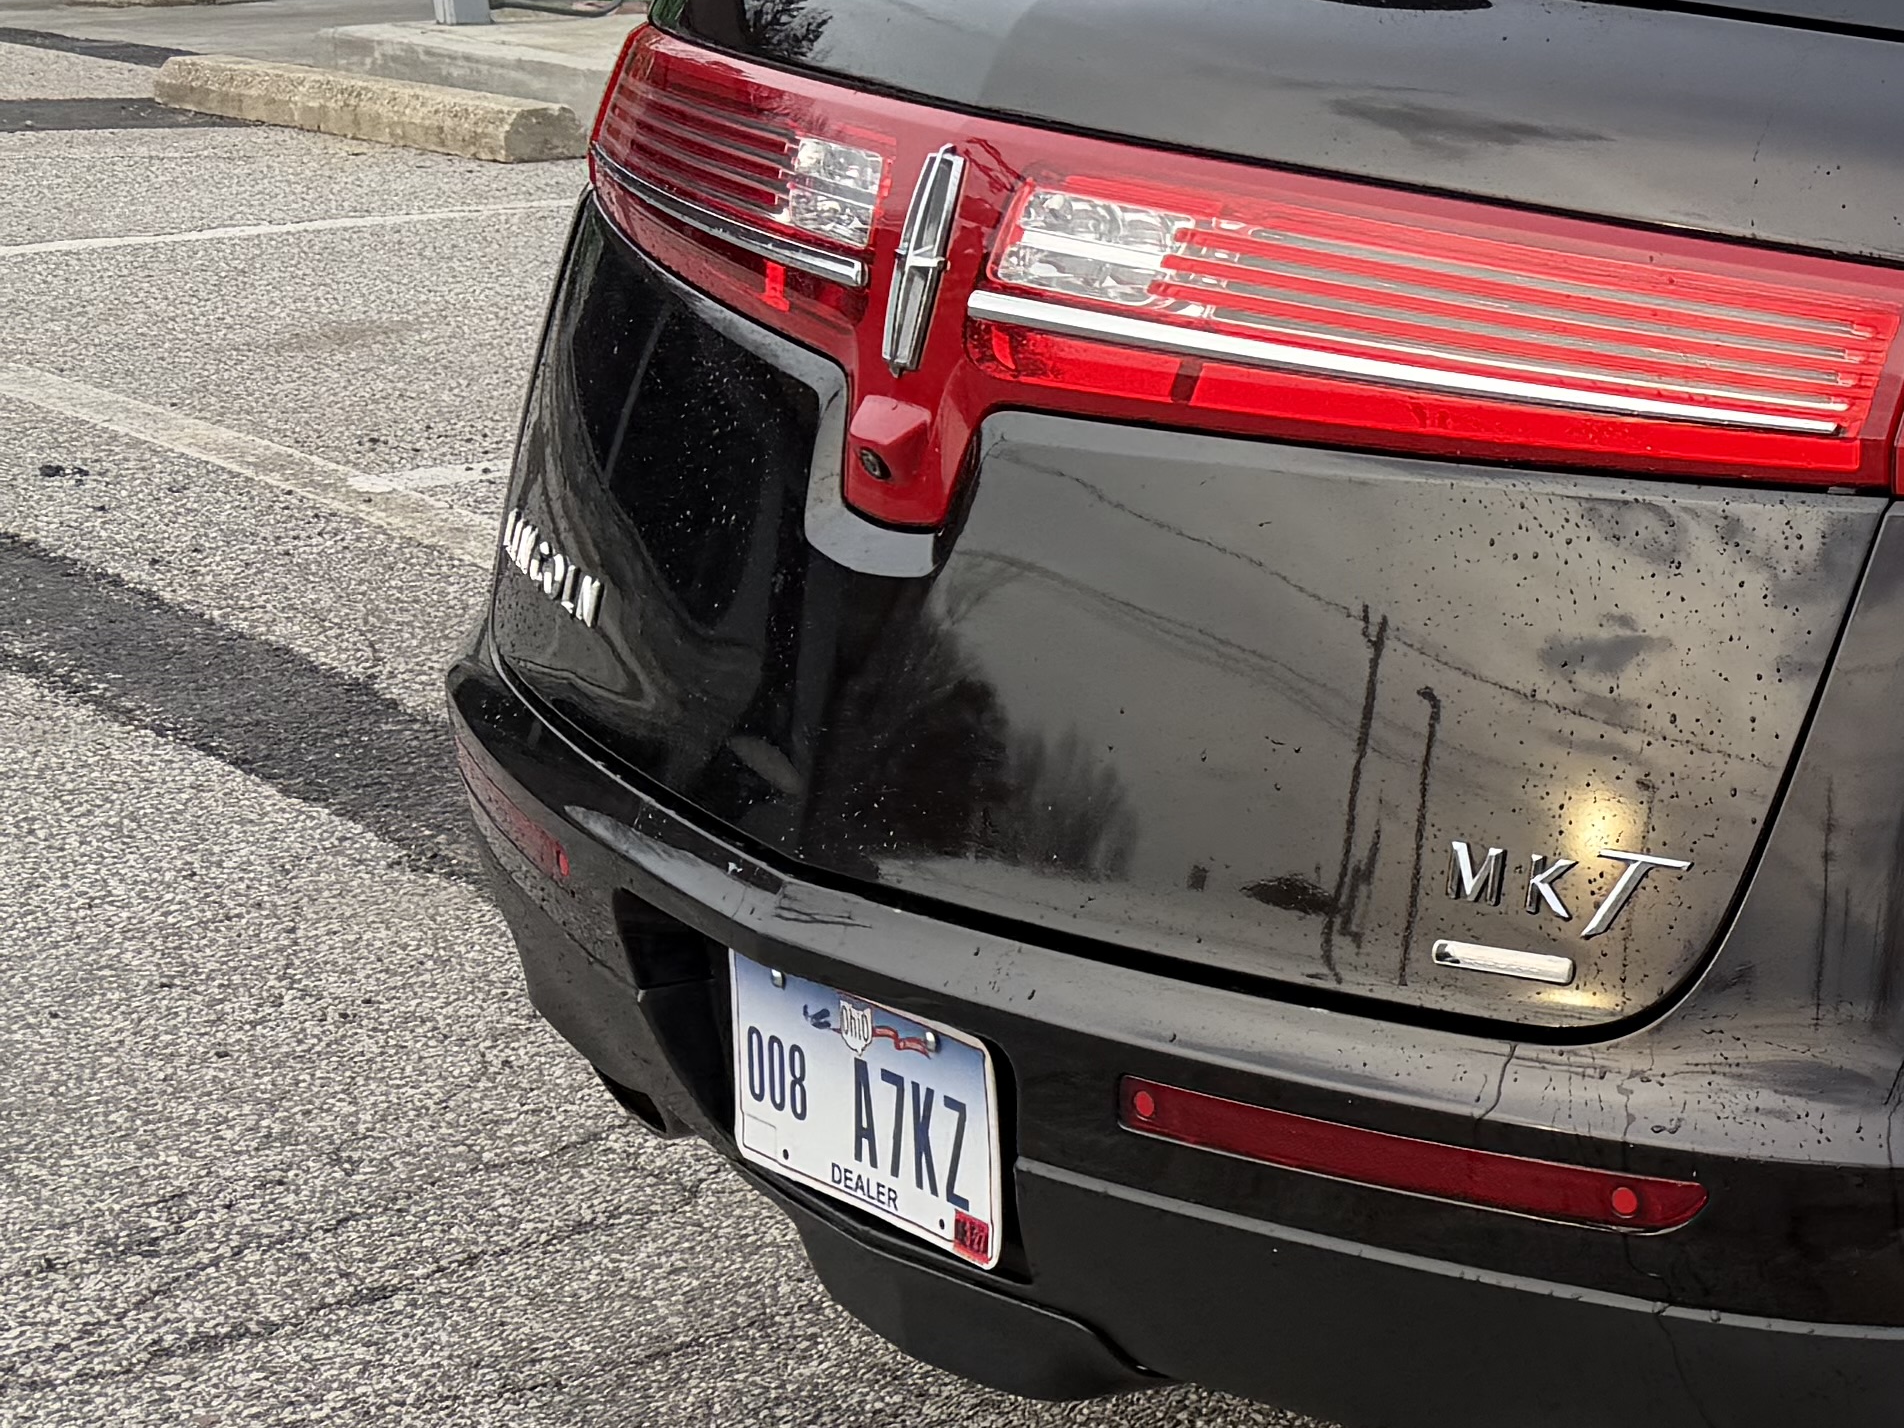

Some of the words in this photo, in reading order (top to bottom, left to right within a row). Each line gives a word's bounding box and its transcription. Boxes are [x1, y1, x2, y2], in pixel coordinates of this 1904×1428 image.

[1448, 840, 1694, 939] MKT
[747, 1025, 808, 1121] 008
[854, 1057, 970, 1212] A7KZ
[831, 1161, 899, 1212] DEALER
